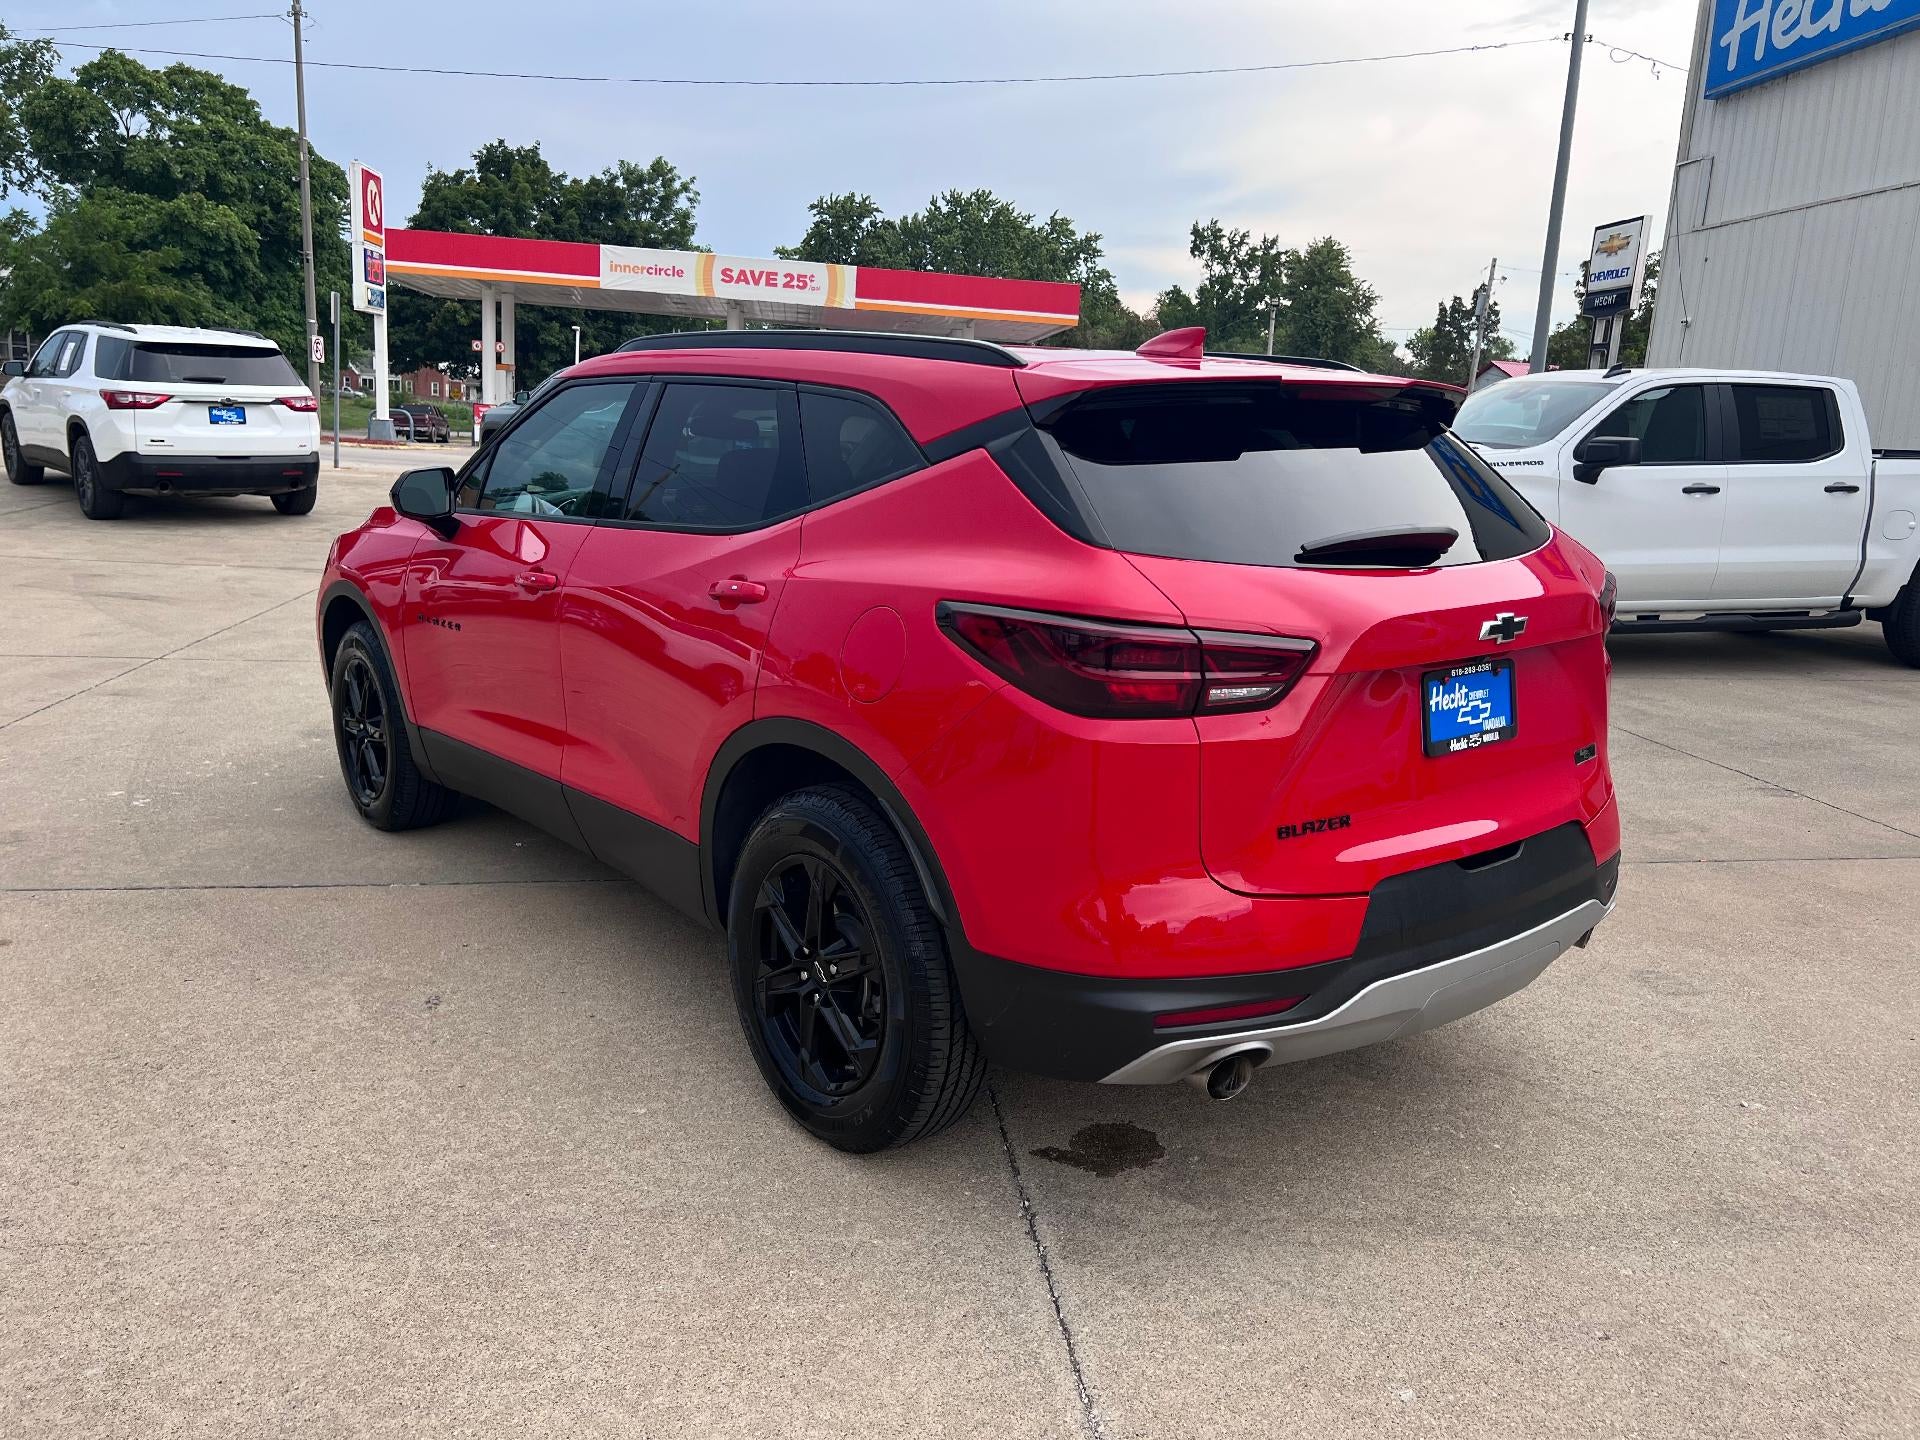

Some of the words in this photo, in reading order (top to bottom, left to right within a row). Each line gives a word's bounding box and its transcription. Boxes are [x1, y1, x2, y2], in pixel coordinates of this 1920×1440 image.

[1720, 0, 1892, 71] Hec
[609, 260, 685, 278] innercircle
[720, 267, 778, 288] SAVE
[1590, 266, 1631, 282] CHEVROLET
[1594, 294, 1617, 307] HECHT
[1430, 682, 1468, 712] Hecht
[1277, 814, 1351, 840] BLAZER
